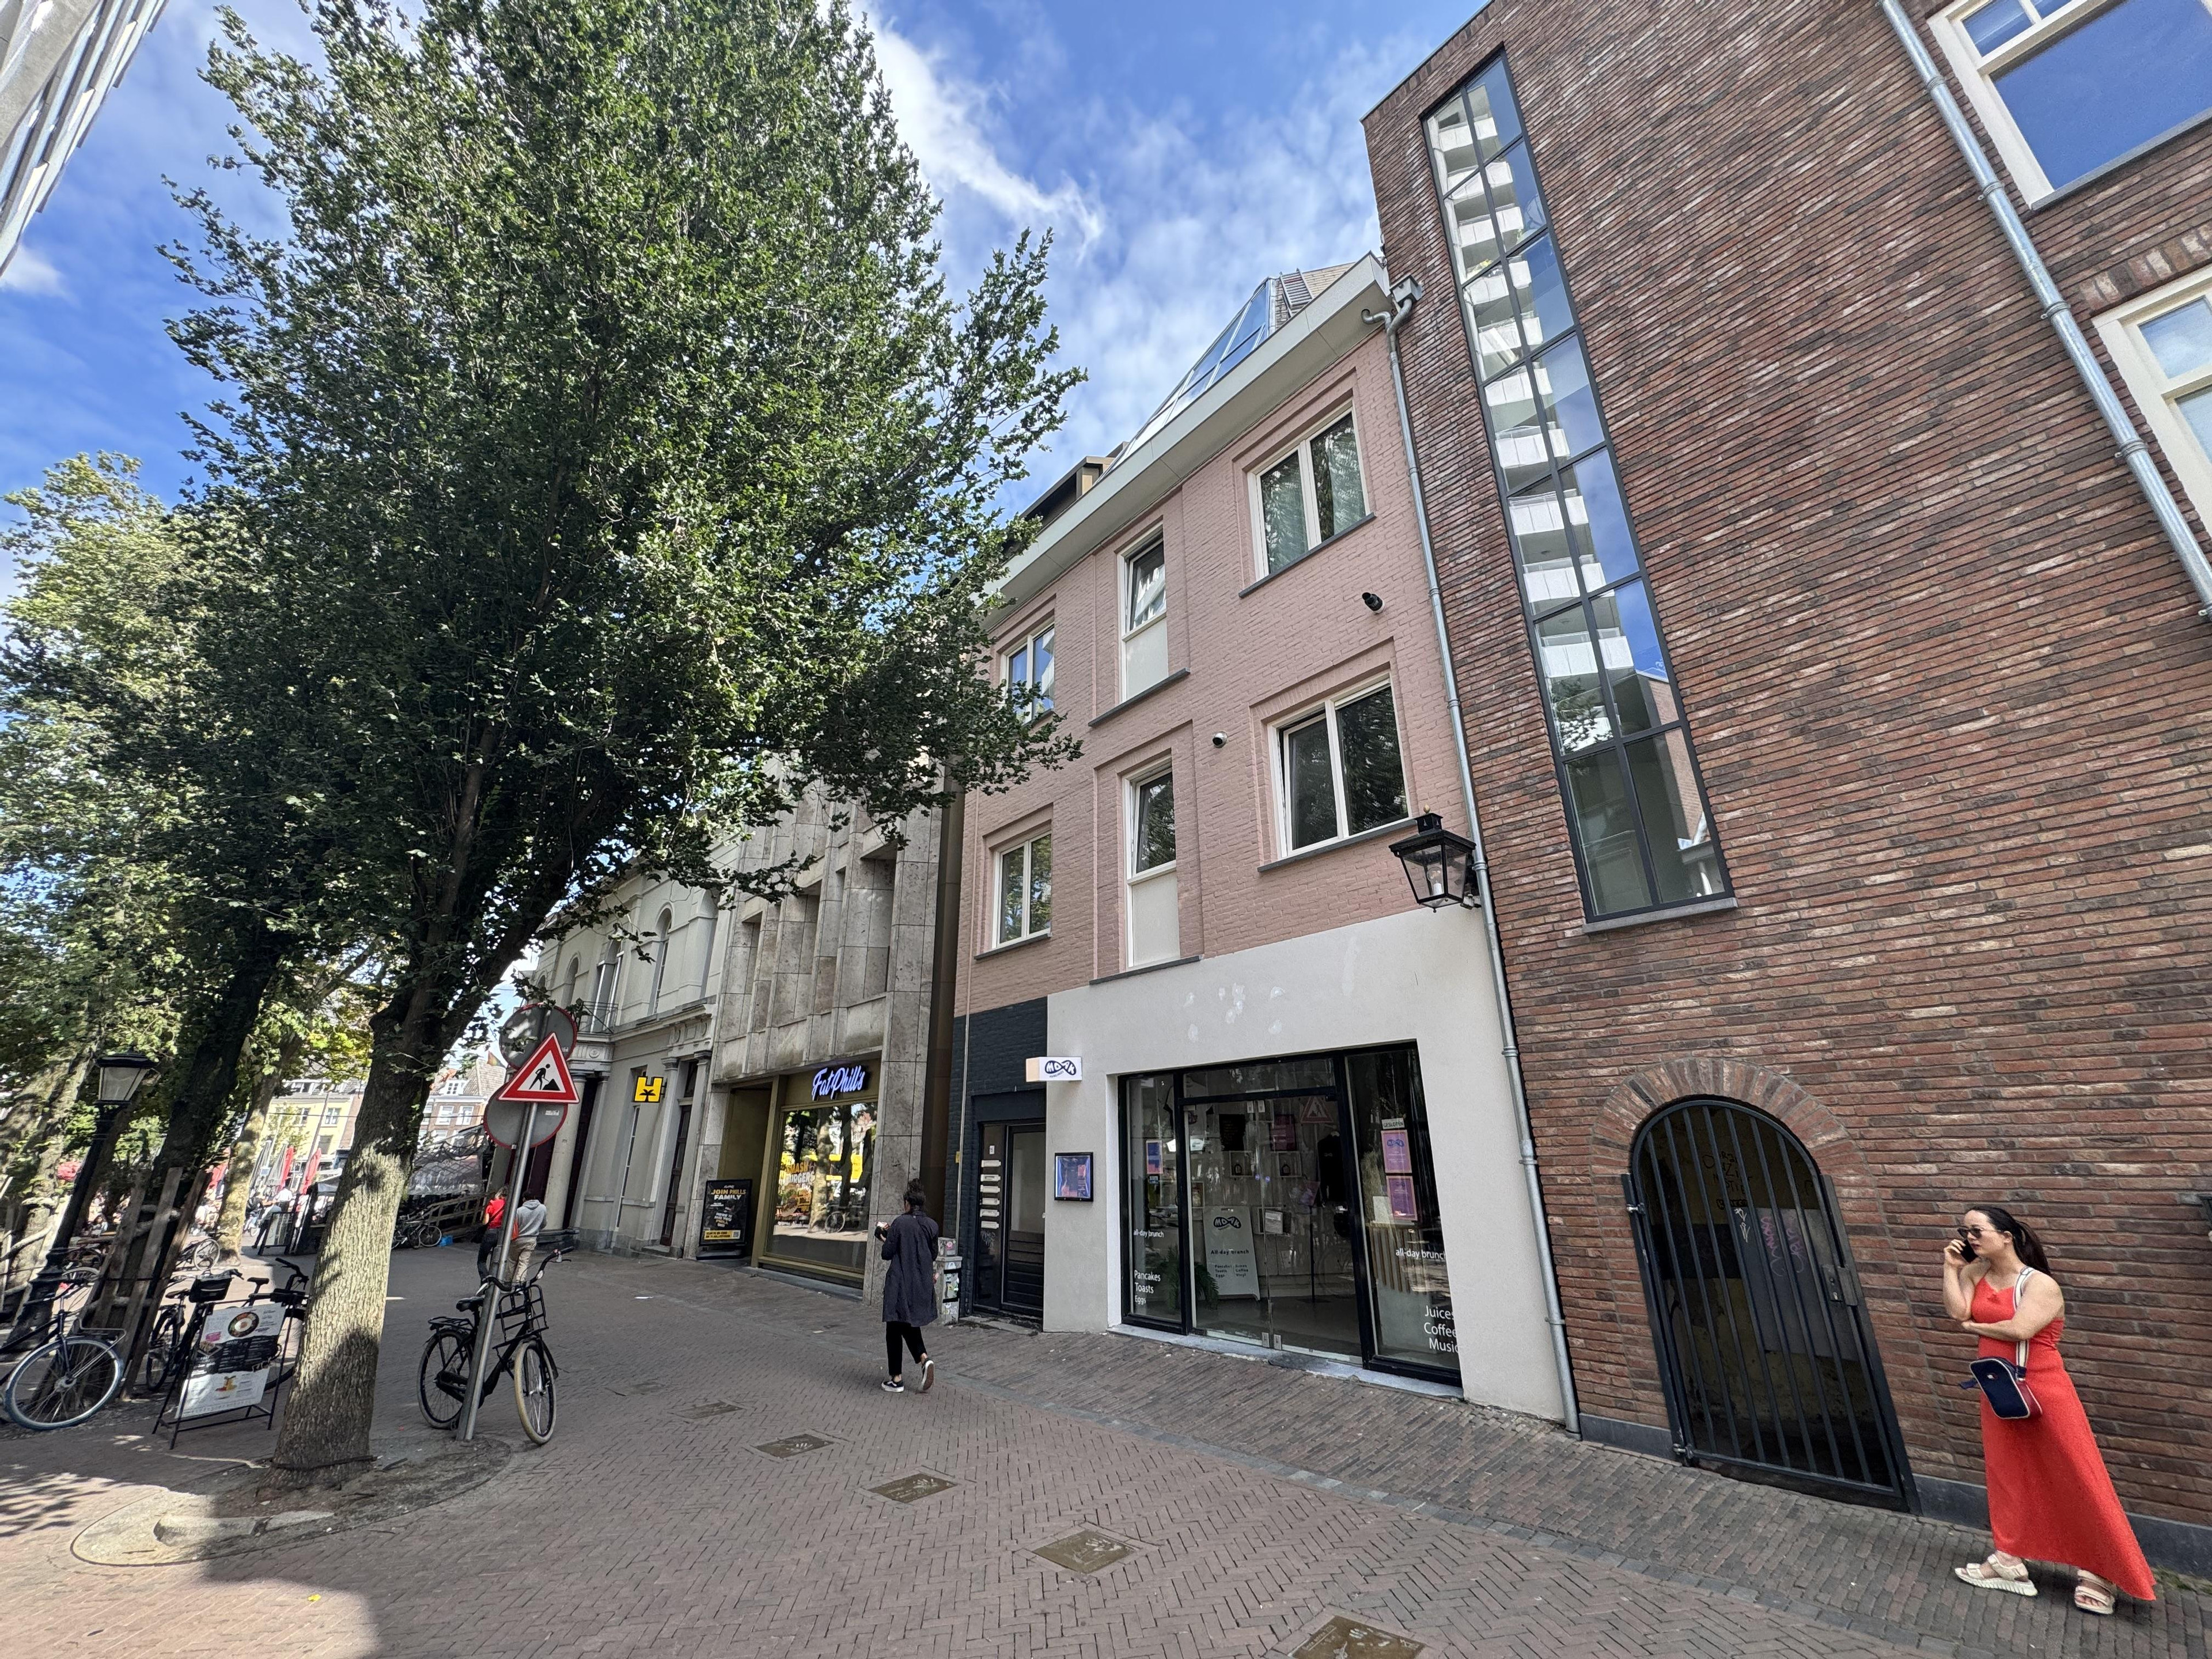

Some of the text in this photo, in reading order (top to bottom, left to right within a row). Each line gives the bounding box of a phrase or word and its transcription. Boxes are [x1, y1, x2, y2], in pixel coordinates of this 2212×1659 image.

[1045, 1060, 1077, 1075] MOAK
[812, 1065, 865, 1101] Fat Phill's
[786, 1161, 808, 1173] SMASH
[1214, 1217, 1241, 1228] MOAK
[1148, 1229, 1164, 1237] brunch
[1396, 1248, 1420, 1260] all-day
[1134, 1270, 1161, 1282] Pancakes
[1135, 1282, 1154, 1294] Toasts
[1135, 1295, 1146, 1305] Eggs
[1424, 1322, 1456, 1338] Coffee
[1429, 1337, 1459, 1353] Music
